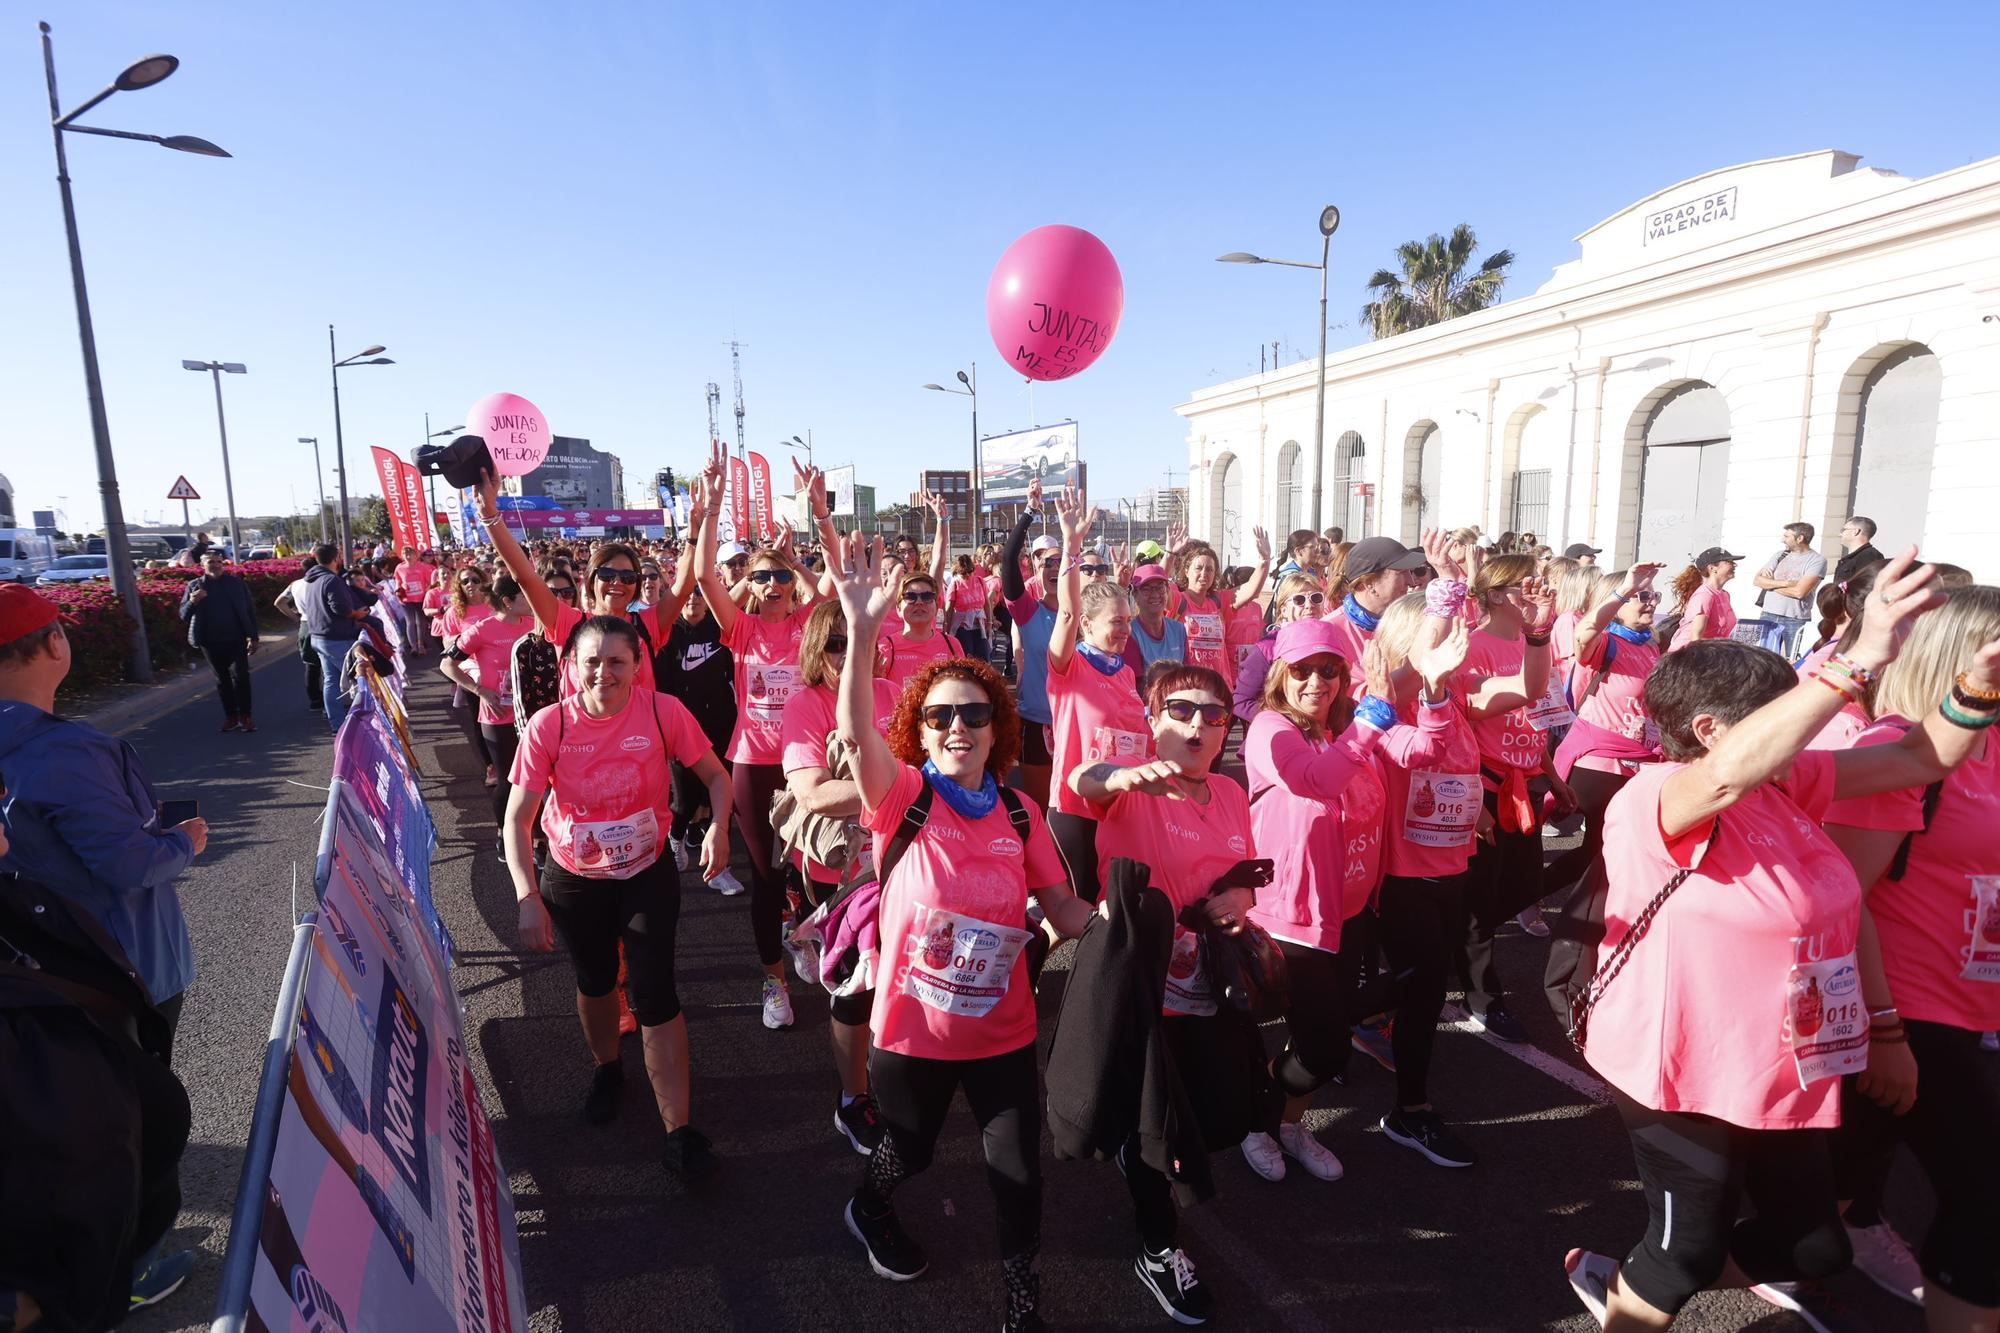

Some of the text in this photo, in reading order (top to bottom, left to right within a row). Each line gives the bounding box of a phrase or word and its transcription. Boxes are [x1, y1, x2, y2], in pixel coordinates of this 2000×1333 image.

[1653, 194, 1727, 227] GRAO DE
[1649, 207, 1728, 240] VALENCIA
[1029, 303, 1111, 353] JUNTAS
[1055, 346, 1078, 363] ES
[490, 415, 538, 432] JUNTAS
[511, 432, 527, 444] ES
[494, 447, 541, 461] MEJOR
[687, 642, 712, 658] NIKE
[768, 687, 789, 696] 016
[1504, 713, 1526, 728] TU
[1502, 732, 1548, 748] DORS
[1501, 751, 1541, 768] SUM
[1437, 802, 1463, 814] 016
[1411, 832, 1438, 841] OYSHO
[605, 843, 632, 855] 016
[954, 955, 987, 972] 016
[921, 974, 950, 989] CARRERA
[955, 973, 976, 983] 6864
[914, 982, 945, 1002] OYSHO
[1826, 1002, 1858, 1024] 016
[1832, 1024, 1853, 1036] 1602
[456, 1155, 470, 1182] a
